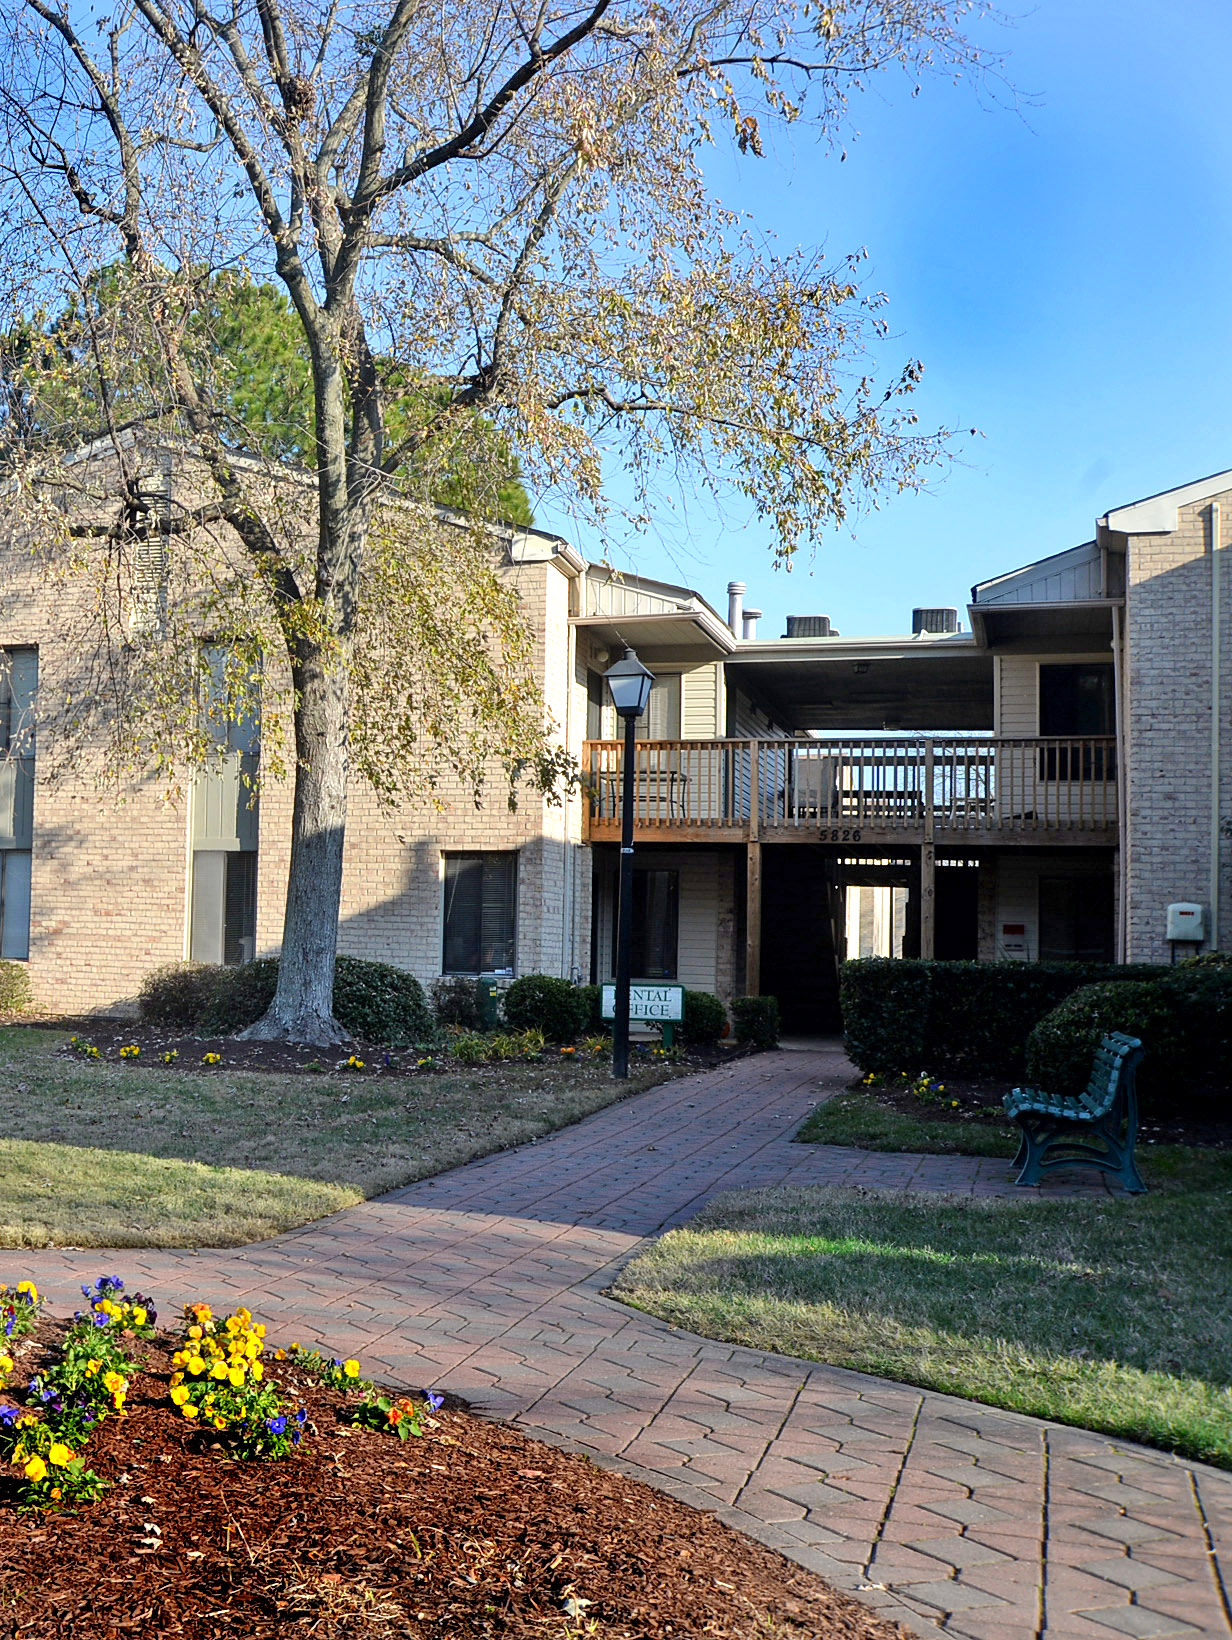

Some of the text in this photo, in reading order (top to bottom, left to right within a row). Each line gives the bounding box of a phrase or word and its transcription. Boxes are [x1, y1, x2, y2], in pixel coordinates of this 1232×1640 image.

[819, 829, 861, 842] 5826
[614, 988, 672, 1002] NTAL
[612, 1003, 670, 1016] FICE
